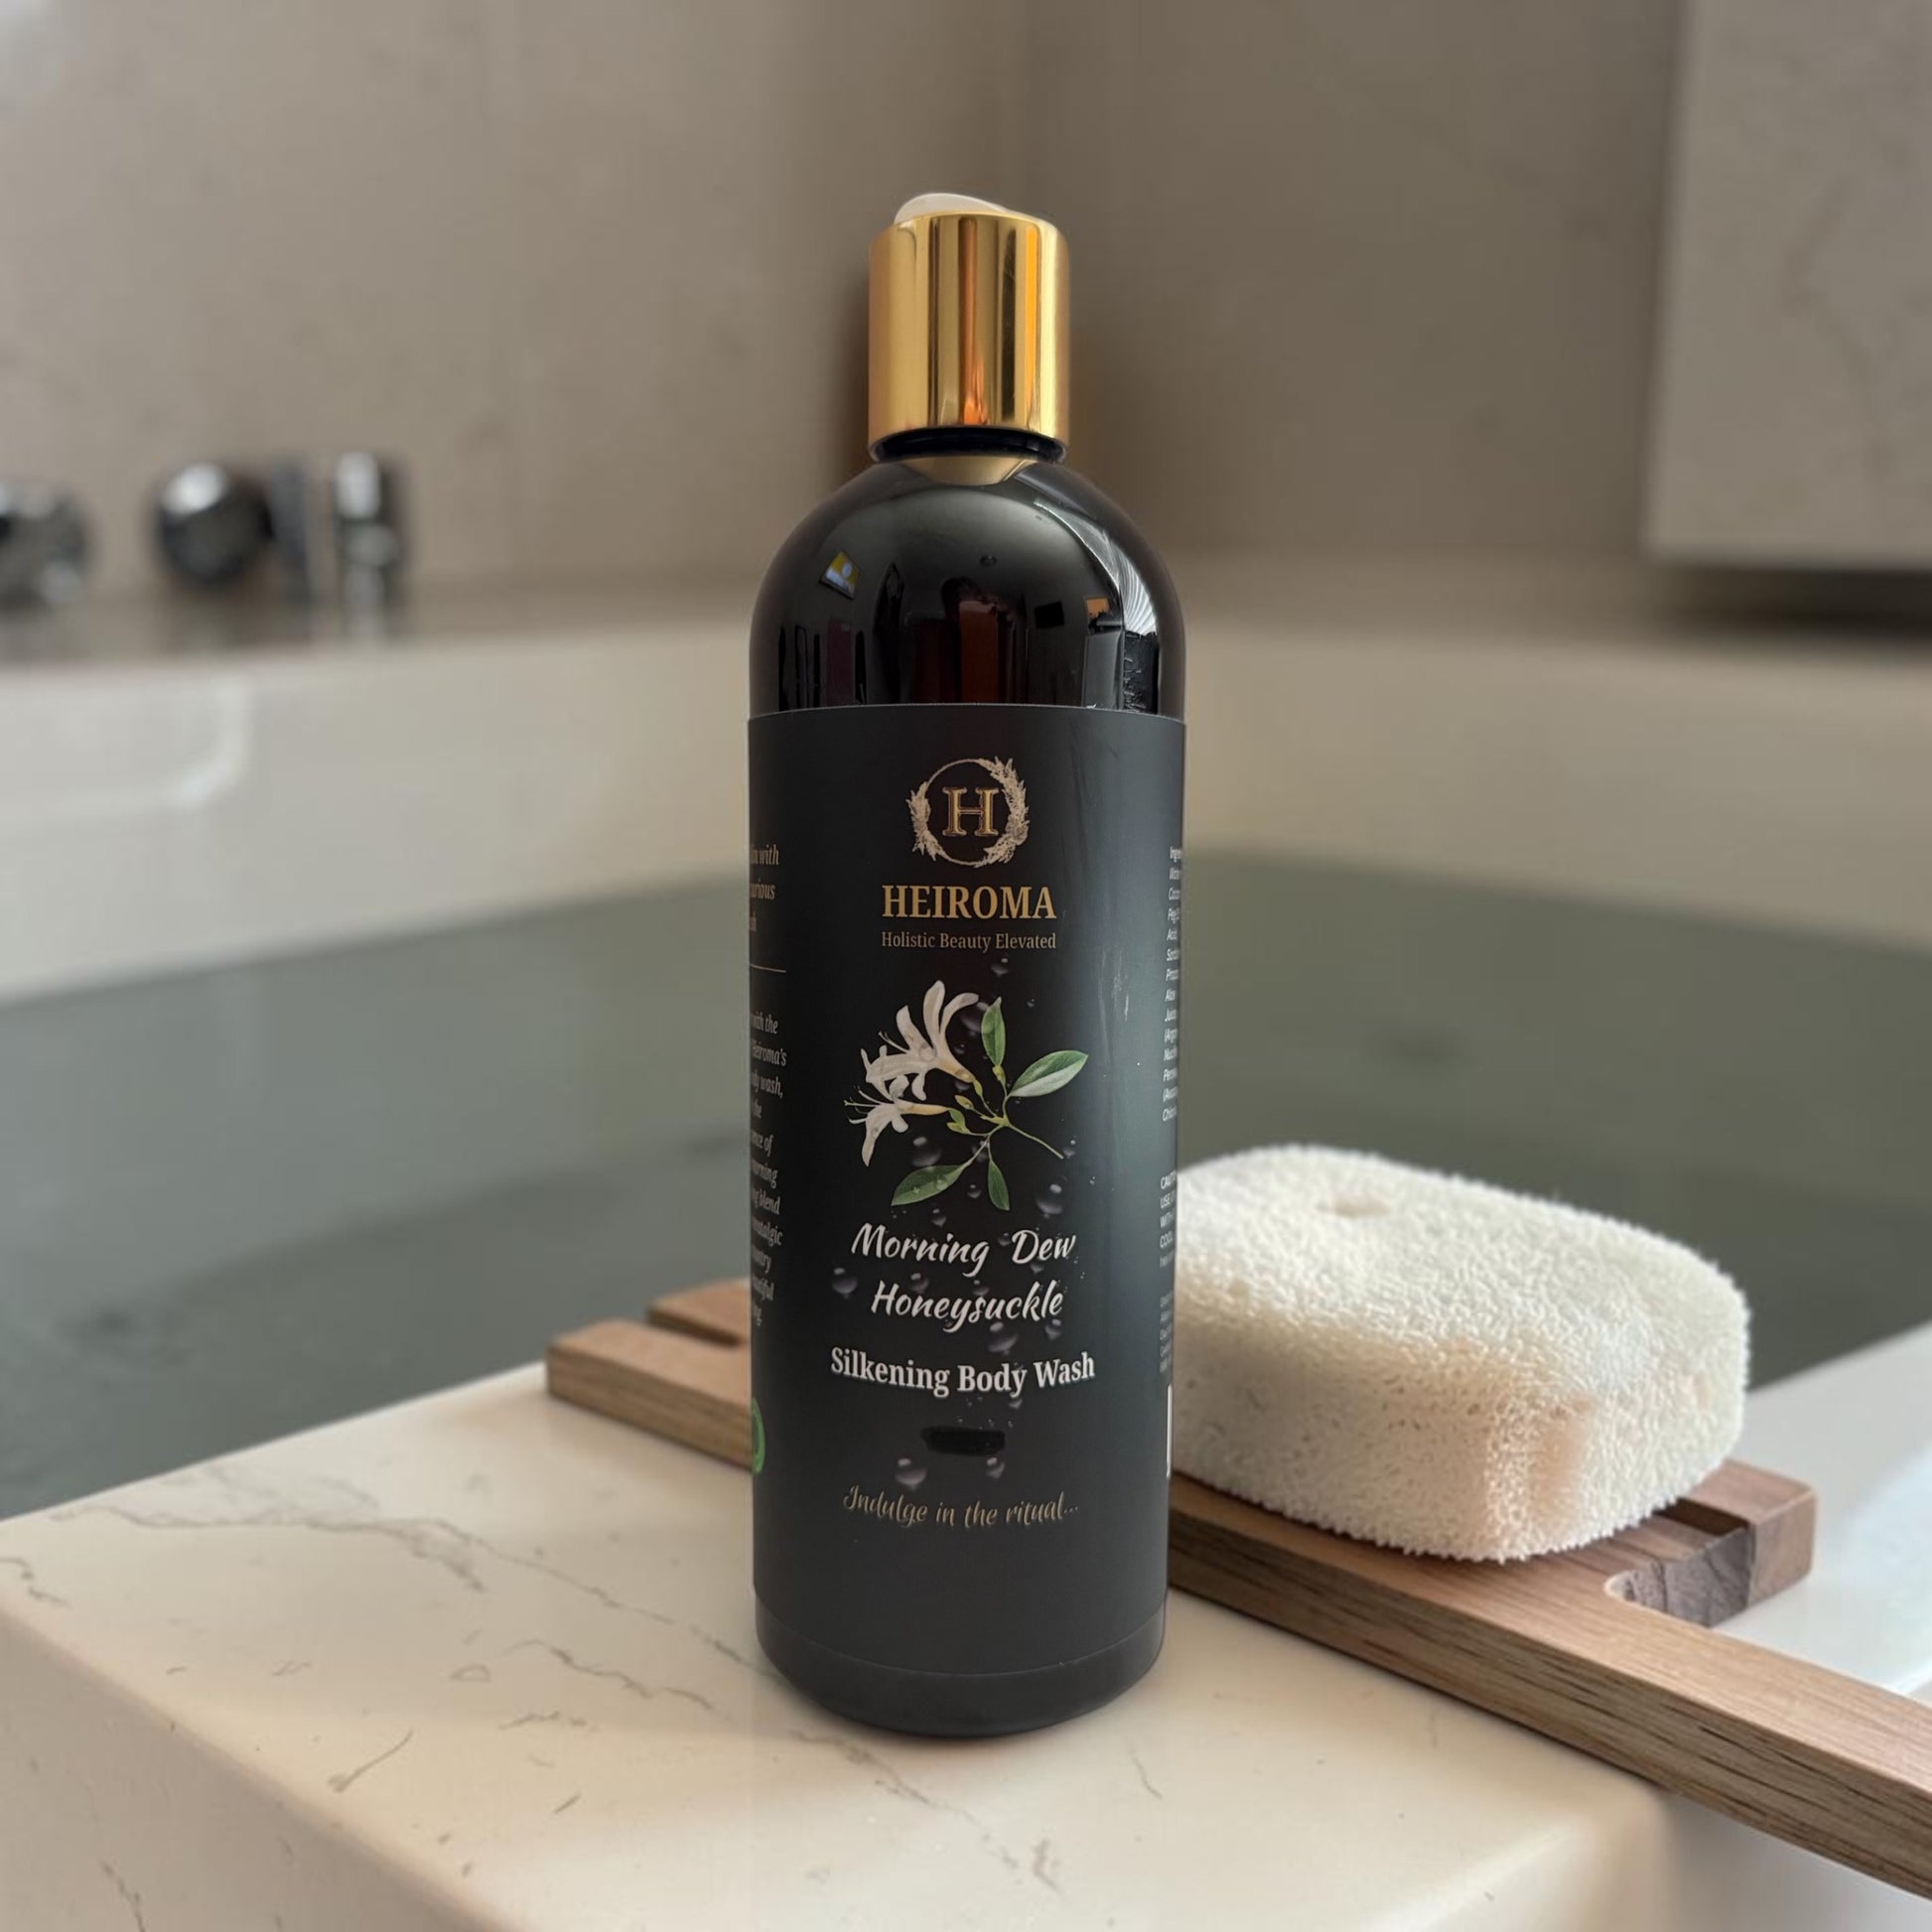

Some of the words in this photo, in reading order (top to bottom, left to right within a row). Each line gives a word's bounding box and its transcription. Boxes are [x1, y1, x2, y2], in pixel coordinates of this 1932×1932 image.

[942, 787, 1000, 837] H
[882, 885, 1057, 919] HEIROMA
[882, 931, 935, 949] Holistic
[939, 932, 991, 953] Beauty
[995, 933, 1056, 949] Elevated
[851, 1223, 990, 1278] Morning
[1011, 1229, 1077, 1265] Dew
[871, 1280, 1064, 1333] Honeysuckle
[831, 1347, 949, 1398] Silkening
[957, 1363, 1028, 1397] Body
[1034, 1351, 1096, 1388] Wash
[843, 1485, 928, 1528] Indulge
[935, 1502, 955, 1526] in
[964, 1500, 998, 1528] the
